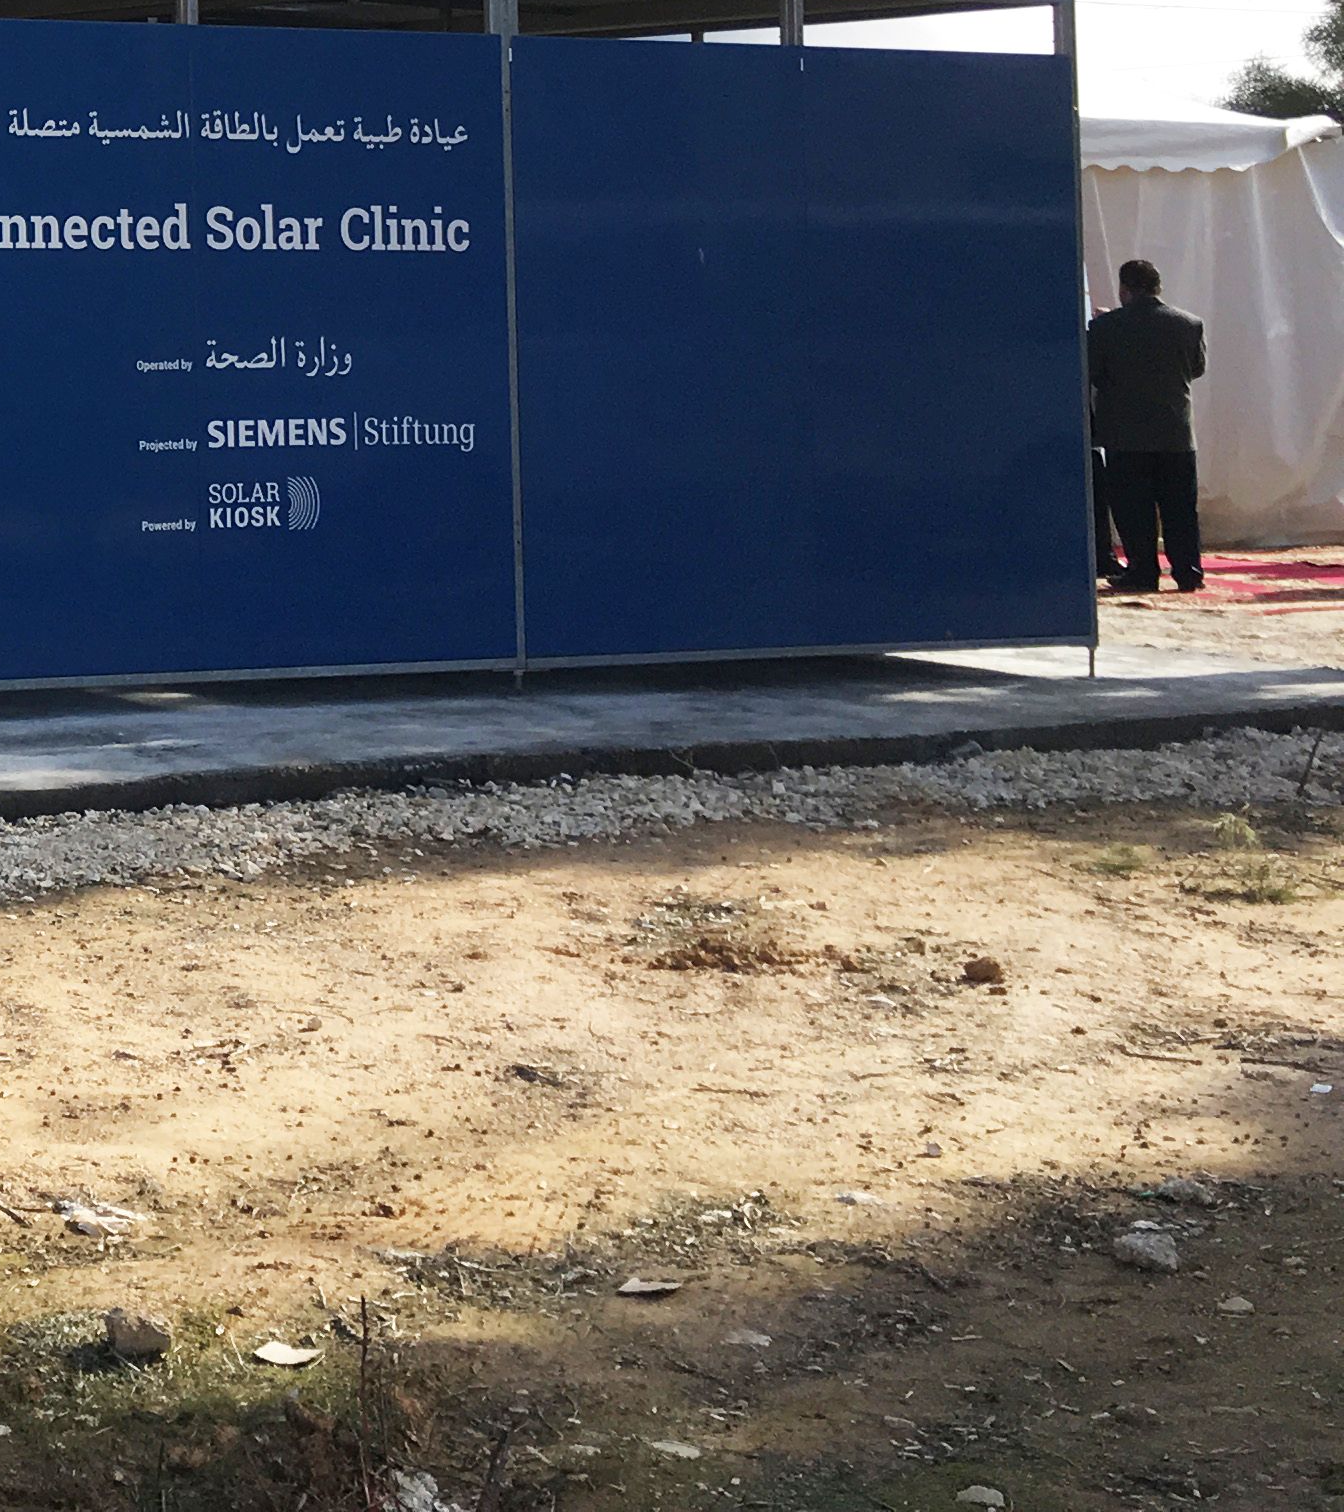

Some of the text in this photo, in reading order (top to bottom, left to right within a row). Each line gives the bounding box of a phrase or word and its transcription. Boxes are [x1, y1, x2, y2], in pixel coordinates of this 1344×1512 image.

[8, 107, 81, 138] متصلة
[88, 109, 190, 146] الشمسية
[200, 109, 279, 147] بالطاقة
[286, 114, 345, 154] تعمل
[353, 114, 403, 150] طبية
[409, 117, 469, 152] عيادة
[206, 203, 323, 251] Solar
[340, 204, 470, 252] Clinic
[136, 359, 193, 372] Operated by
[205, 335, 352, 377] وزارة الصحة
[138, 439, 198, 453] Projected by
[207, 413, 476, 453] SIEMENS Stiftung
[208, 482, 281, 505] SOLAR
[141, 519, 197, 533] Powered by
[209, 506, 281, 529] KIOSK
